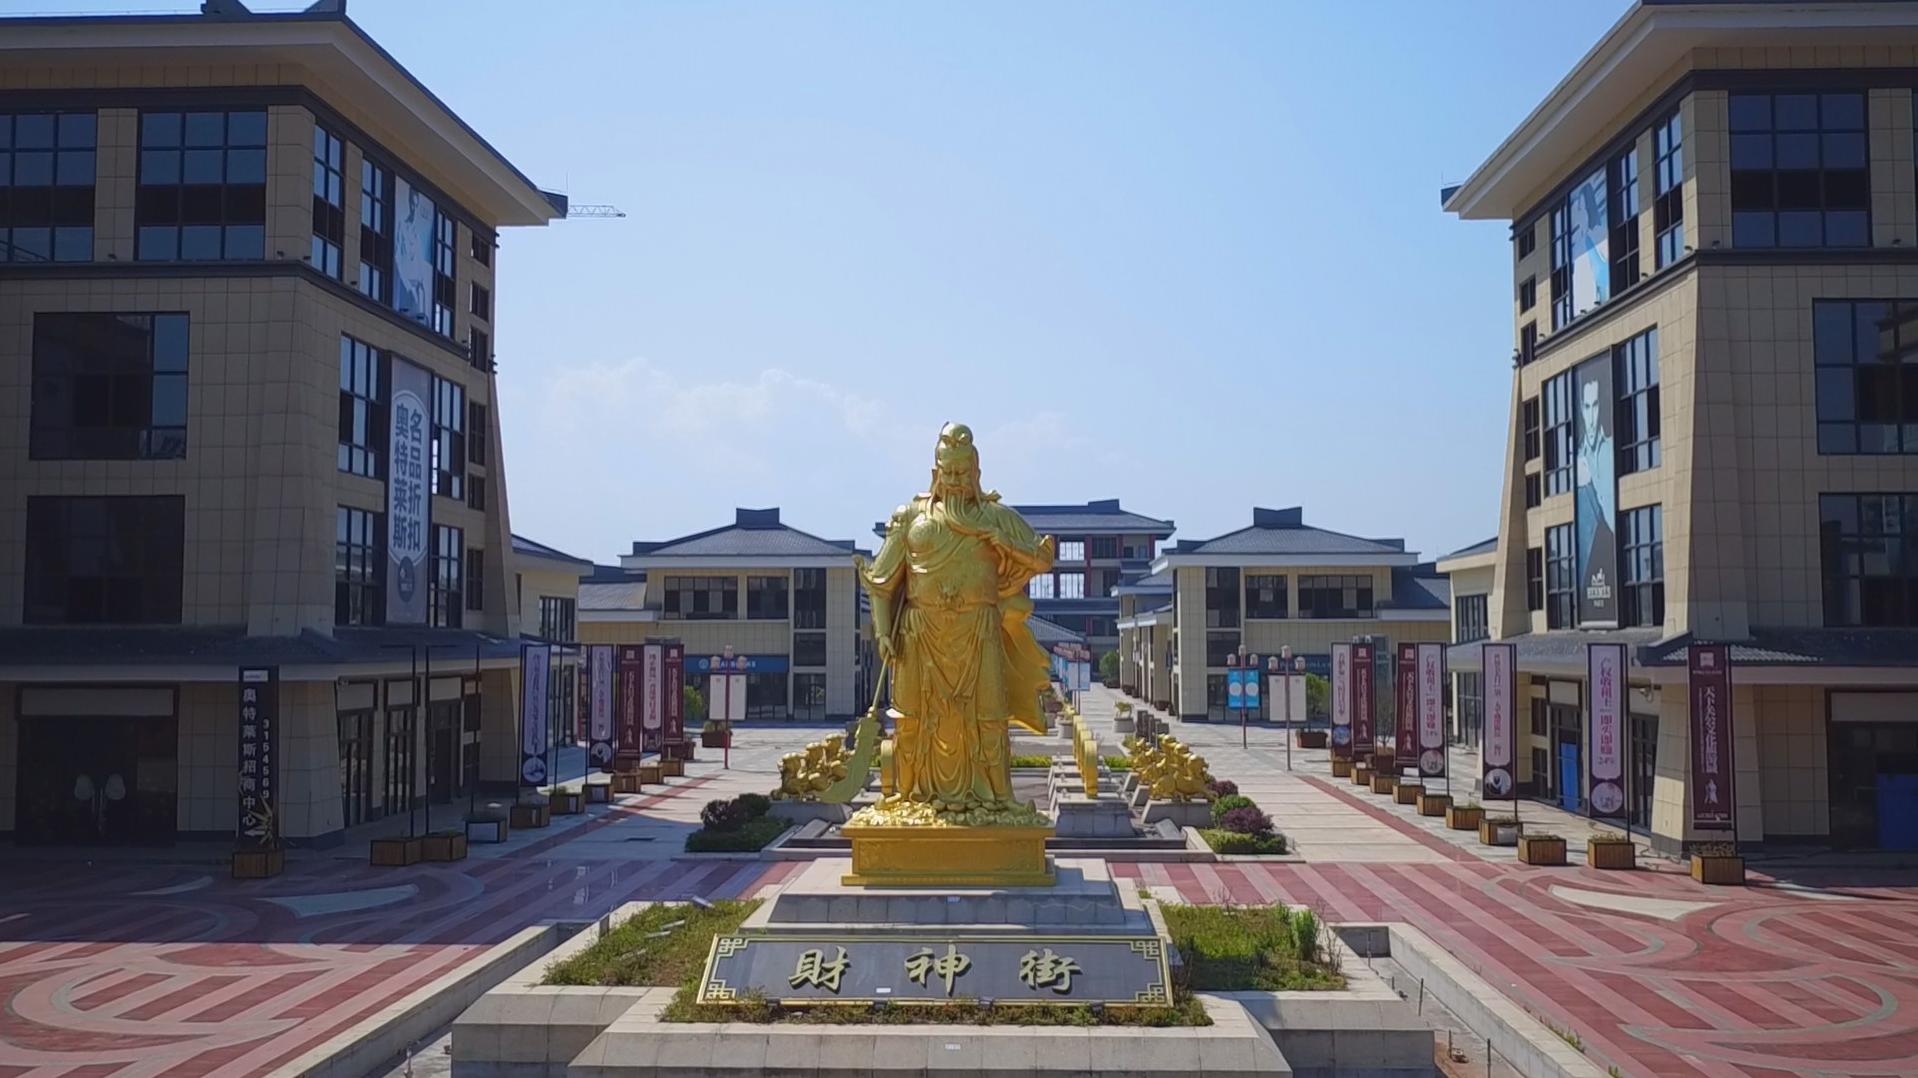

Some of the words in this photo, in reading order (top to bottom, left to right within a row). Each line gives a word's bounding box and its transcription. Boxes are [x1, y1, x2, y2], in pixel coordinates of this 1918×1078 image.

[393, 402, 409, 549] 奥特莱斯
[407, 408, 423, 553] 名品折扣
[242, 688, 257, 826] 奥特莱斯招商中心
[787, 941, 1084, 996] 財神街
